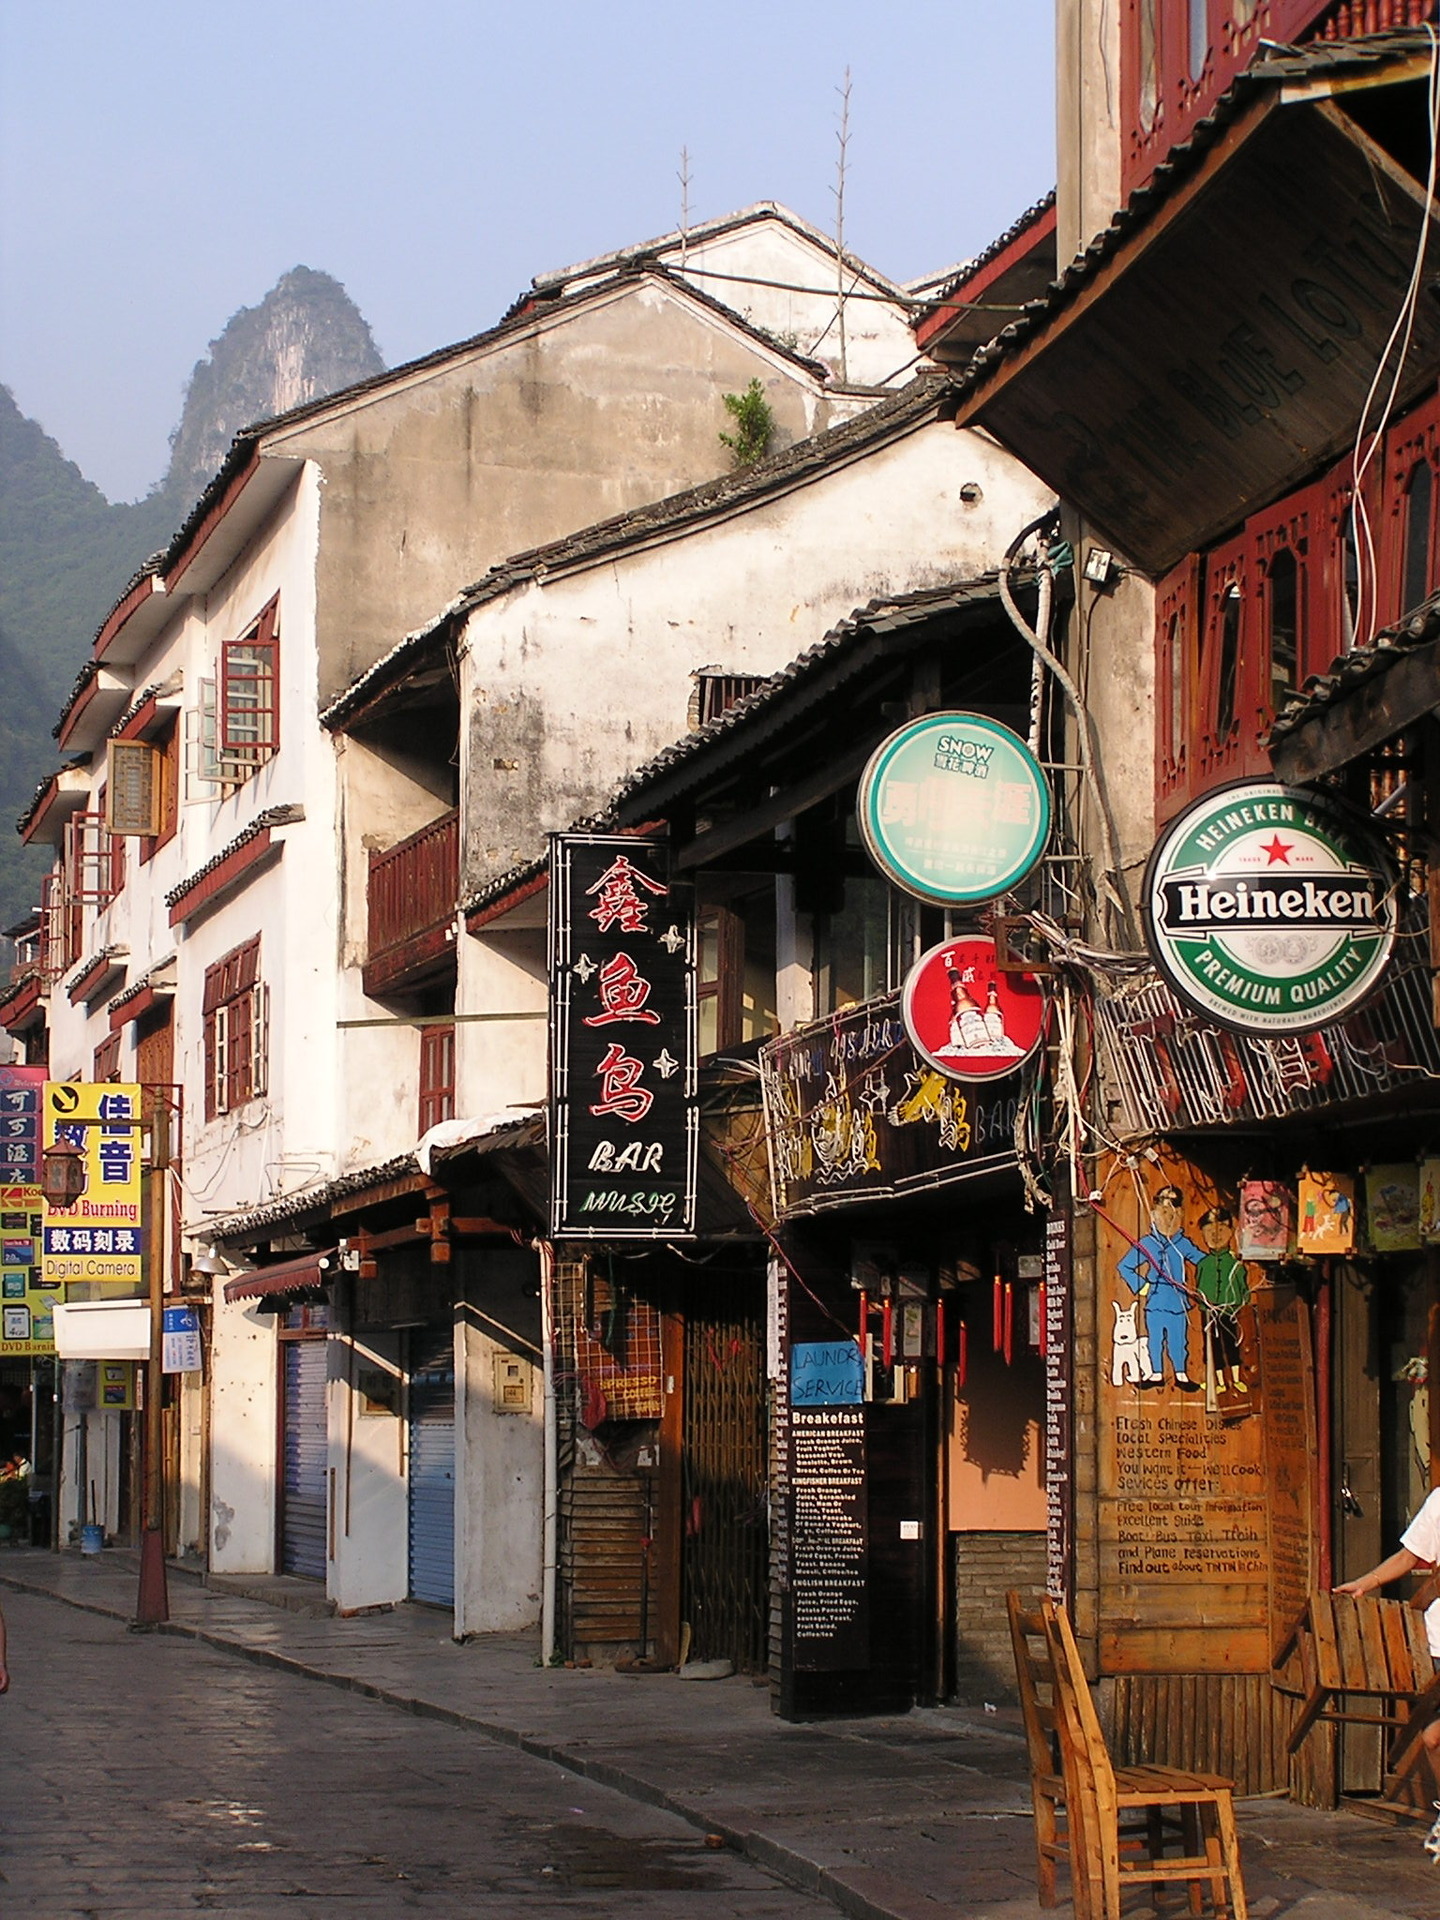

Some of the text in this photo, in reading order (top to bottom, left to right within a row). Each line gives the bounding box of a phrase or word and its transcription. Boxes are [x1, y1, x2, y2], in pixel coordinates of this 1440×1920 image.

[1168, 322, 1304, 439] BLUE
[937, 735, 994, 764] SNOW
[1196, 803, 1294, 851] HEINEKEN
[1178, 881, 1374, 921] Heineken
[1194, 947, 1362, 1005] PREMIUM QUALITY
[588, 1140, 664, 1173] BAR
[82, 1200, 137, 1221] Burning
[51, 1229, 134, 1252] 数码刻录
[46, 1260, 83, 1278] Digital
[1, 1342, 22, 1350] DVD
[793, 1376, 862, 1400] SERVICE
[792, 1411, 864, 1424] Breakefast
[1116, 1416, 1242, 1430] Fresh Chinese Dises
[1177, 1447, 1206, 1460] Food
[1117, 1461, 1139, 1475] You
[1118, 1476, 1168, 1490] Sevices
[1117, 1501, 1143, 1512] Free
[1117, 1515, 1168, 1526] Excellent
[1118, 1546, 1260, 1559] and Plane reservations
[1118, 1560, 1144, 1574] Find
[1145, 1562, 1170, 1574] out
[1172, 1560, 1203, 1573] about
